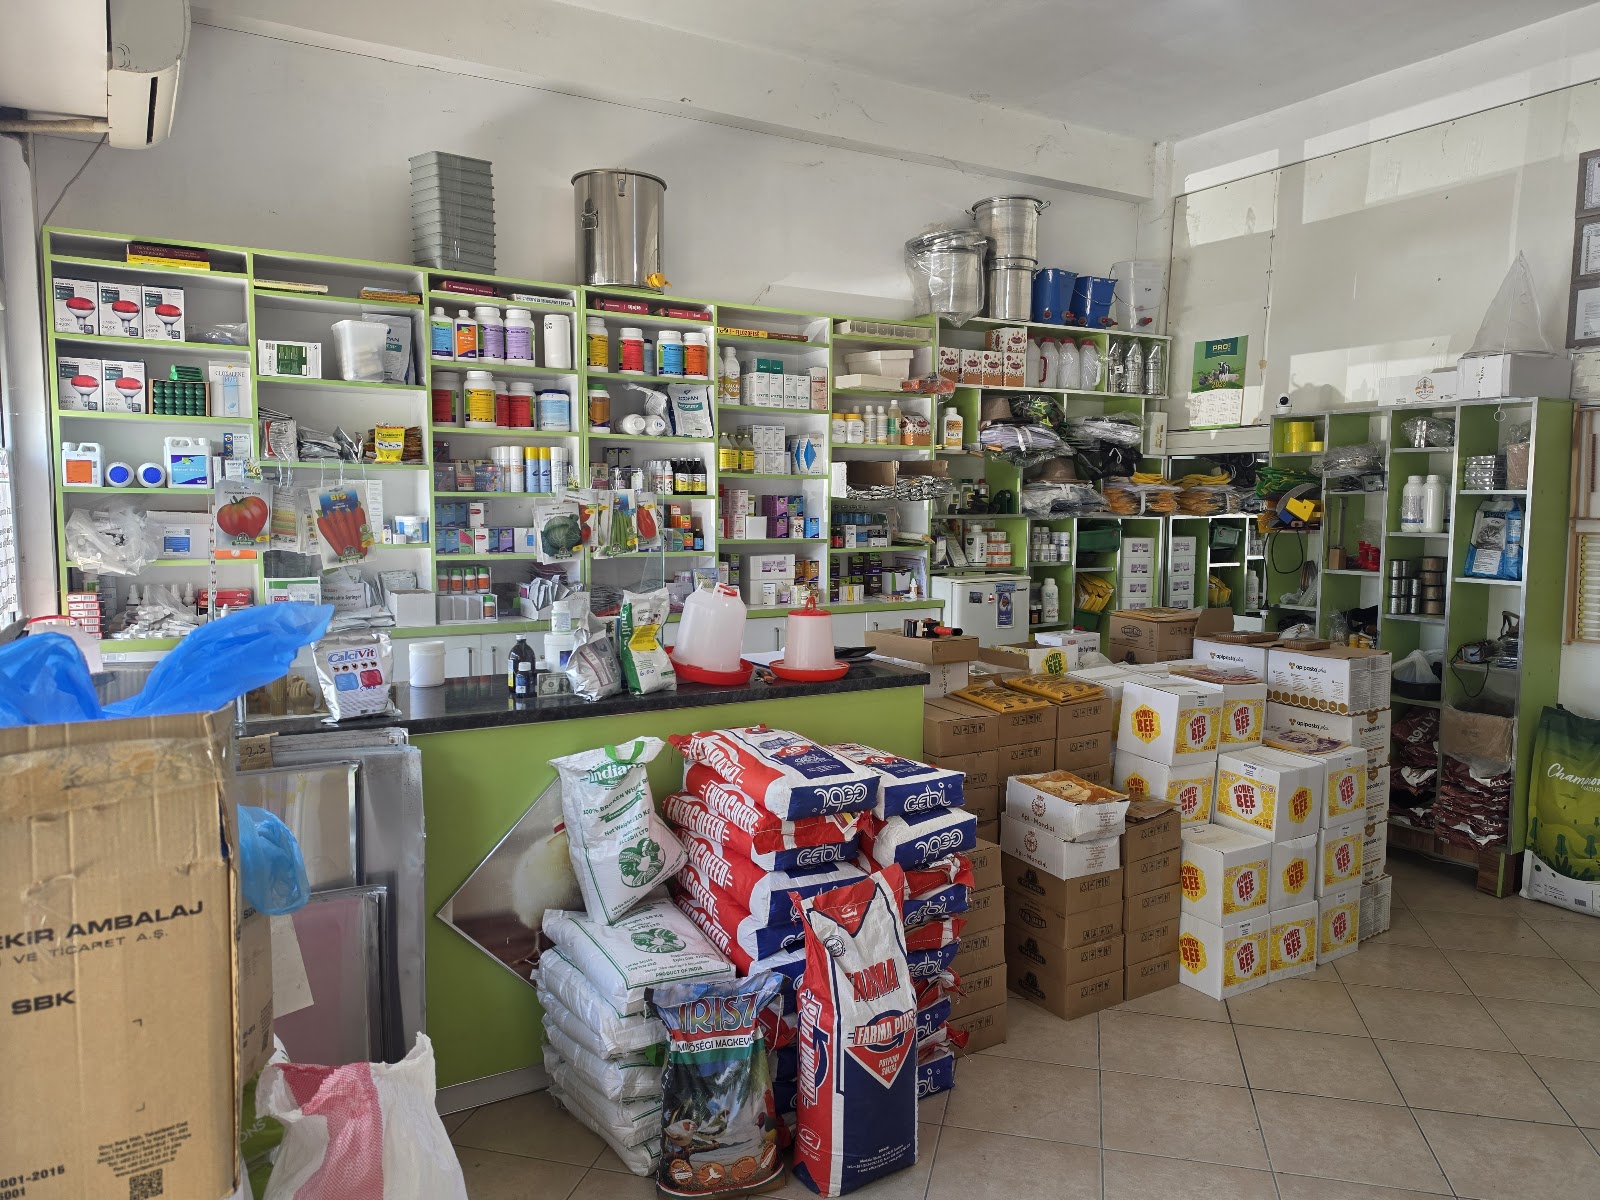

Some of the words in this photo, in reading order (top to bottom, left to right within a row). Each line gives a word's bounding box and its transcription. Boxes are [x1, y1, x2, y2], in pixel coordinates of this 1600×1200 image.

[1212, 343, 1228, 352] PRO
[328, 648, 376, 665] CalciVit
[1135, 710, 1154, 719] HONEY
[1233, 706, 1250, 719] HONEY
[1136, 718, 1155, 733] BEE
[1189, 715, 1206, 728] HONEY
[1234, 716, 1250, 732] BEE
[1407, 712, 1436, 743] ROLLY
[1191, 725, 1206, 741] BEE
[1126, 777, 1145, 788] HONEY
[1233, 784, 1254, 795] HONEY
[1338, 775, 1353, 789] HONEY
[1179, 786, 1198, 798] HONEY
[1292, 790, 1307, 804] HONEY
[1340, 785, 1355, 802] BEE
[1181, 795, 1198, 811] BEE
[1235, 793, 1256, 809] BEE
[1293, 800, 1308, 816] BEE
[604, 828, 616, 837] Net
[1335, 843, 1349, 860] HONEY
[1286, 861, 1304, 875] HONEY
[1336, 854, 1351, 871] BEE
[1180, 865, 1199, 877] HONEY
[1236, 870, 1253, 888] HONEY
[1288, 871, 1304, 887] BEE
[1181, 874, 1200, 891] BEE
[1238, 882, 1255, 900] BEE
[66, 900, 204, 939] AMBALAJ
[1332, 911, 1347, 928] HONEY
[1283, 928, 1300, 945] HONEY
[1333, 922, 1347, 939] BEE
[1179, 936, 1199, 948] HONEY
[1285, 940, 1302, 958] BEE
[13, 952, 38, 964] VE
[1181, 946, 1200, 963] BEE
[1236, 942, 1254, 959] HONEY
[1238, 954, 1255, 972] BEE
[655, 969, 681, 978] PRODUCT
[688, 965, 704, 973] INDIA
[11, 989, 76, 1016] SBK
[857, 1021, 893, 1044] FARMA
[800, 1048, 815, 1098] FARMA
